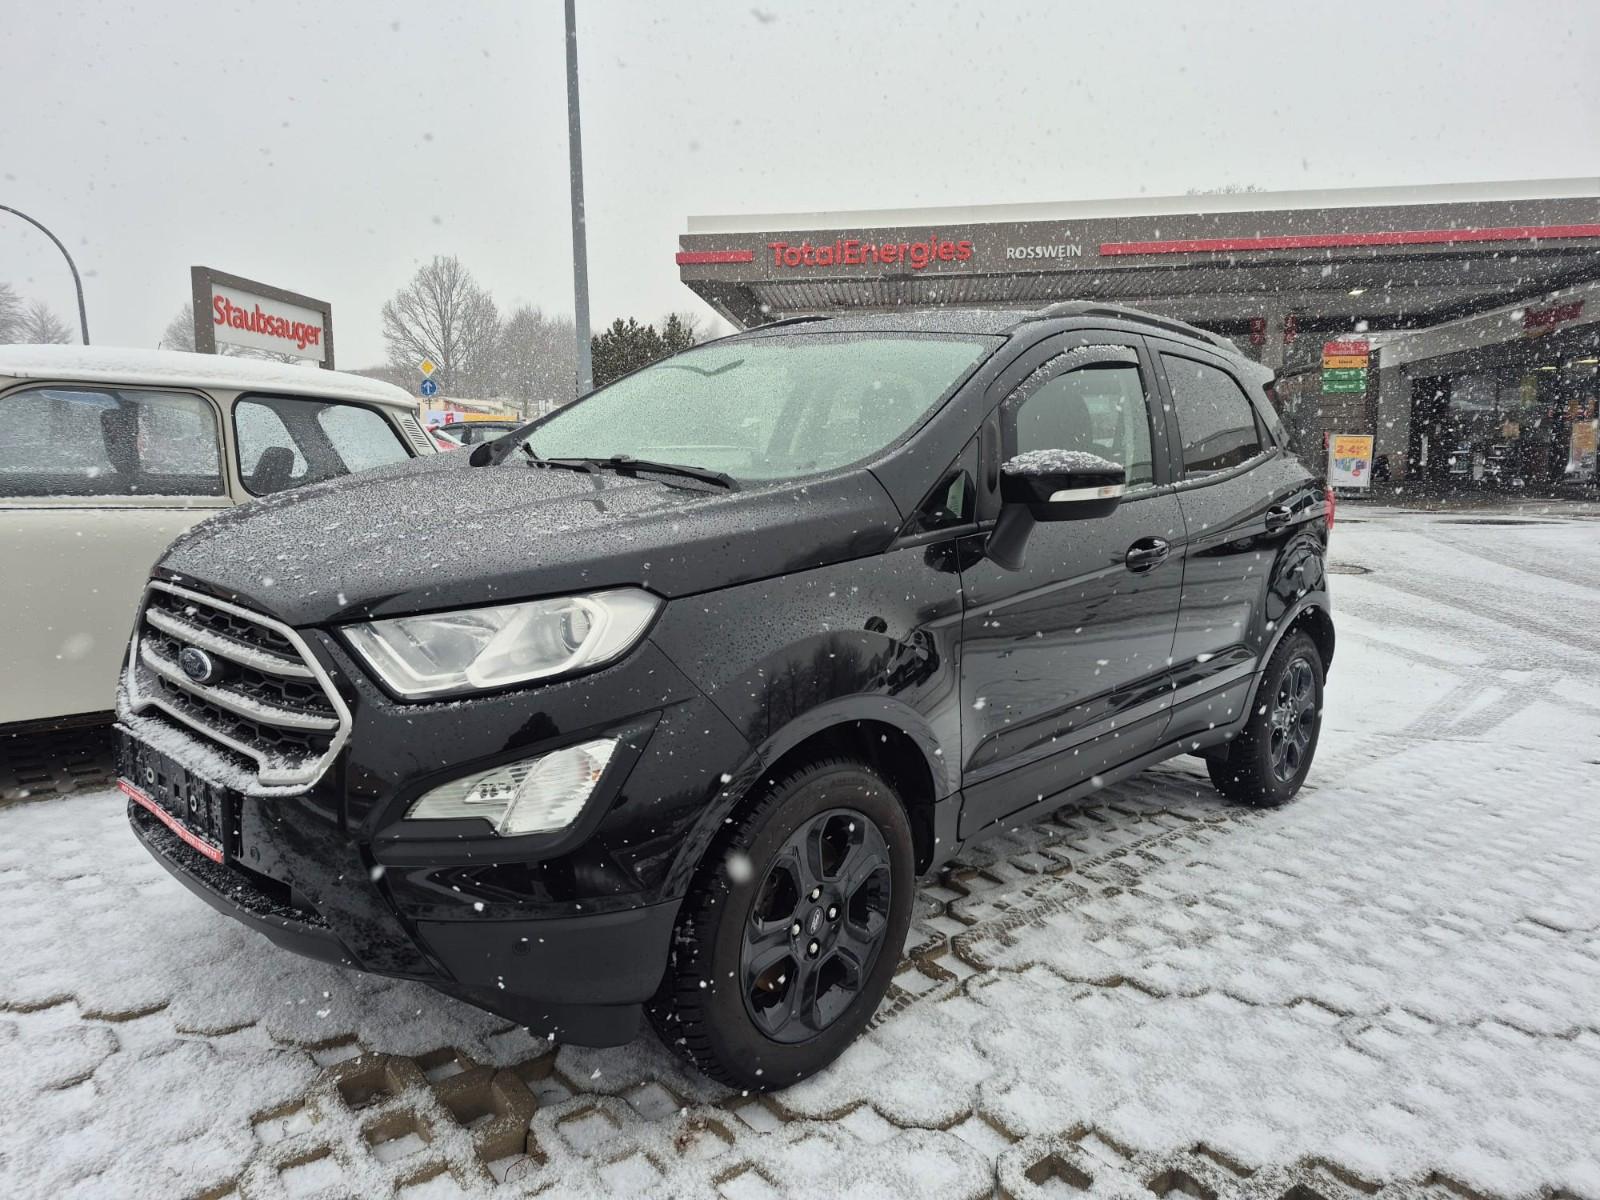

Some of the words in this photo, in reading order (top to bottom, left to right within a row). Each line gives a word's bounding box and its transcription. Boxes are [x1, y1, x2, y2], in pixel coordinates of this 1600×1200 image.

[767, 234, 972, 269] TotalEnergies
[1006, 244, 1082, 259] ROSSWEIN
[213, 295, 321, 350] Staubsauger
